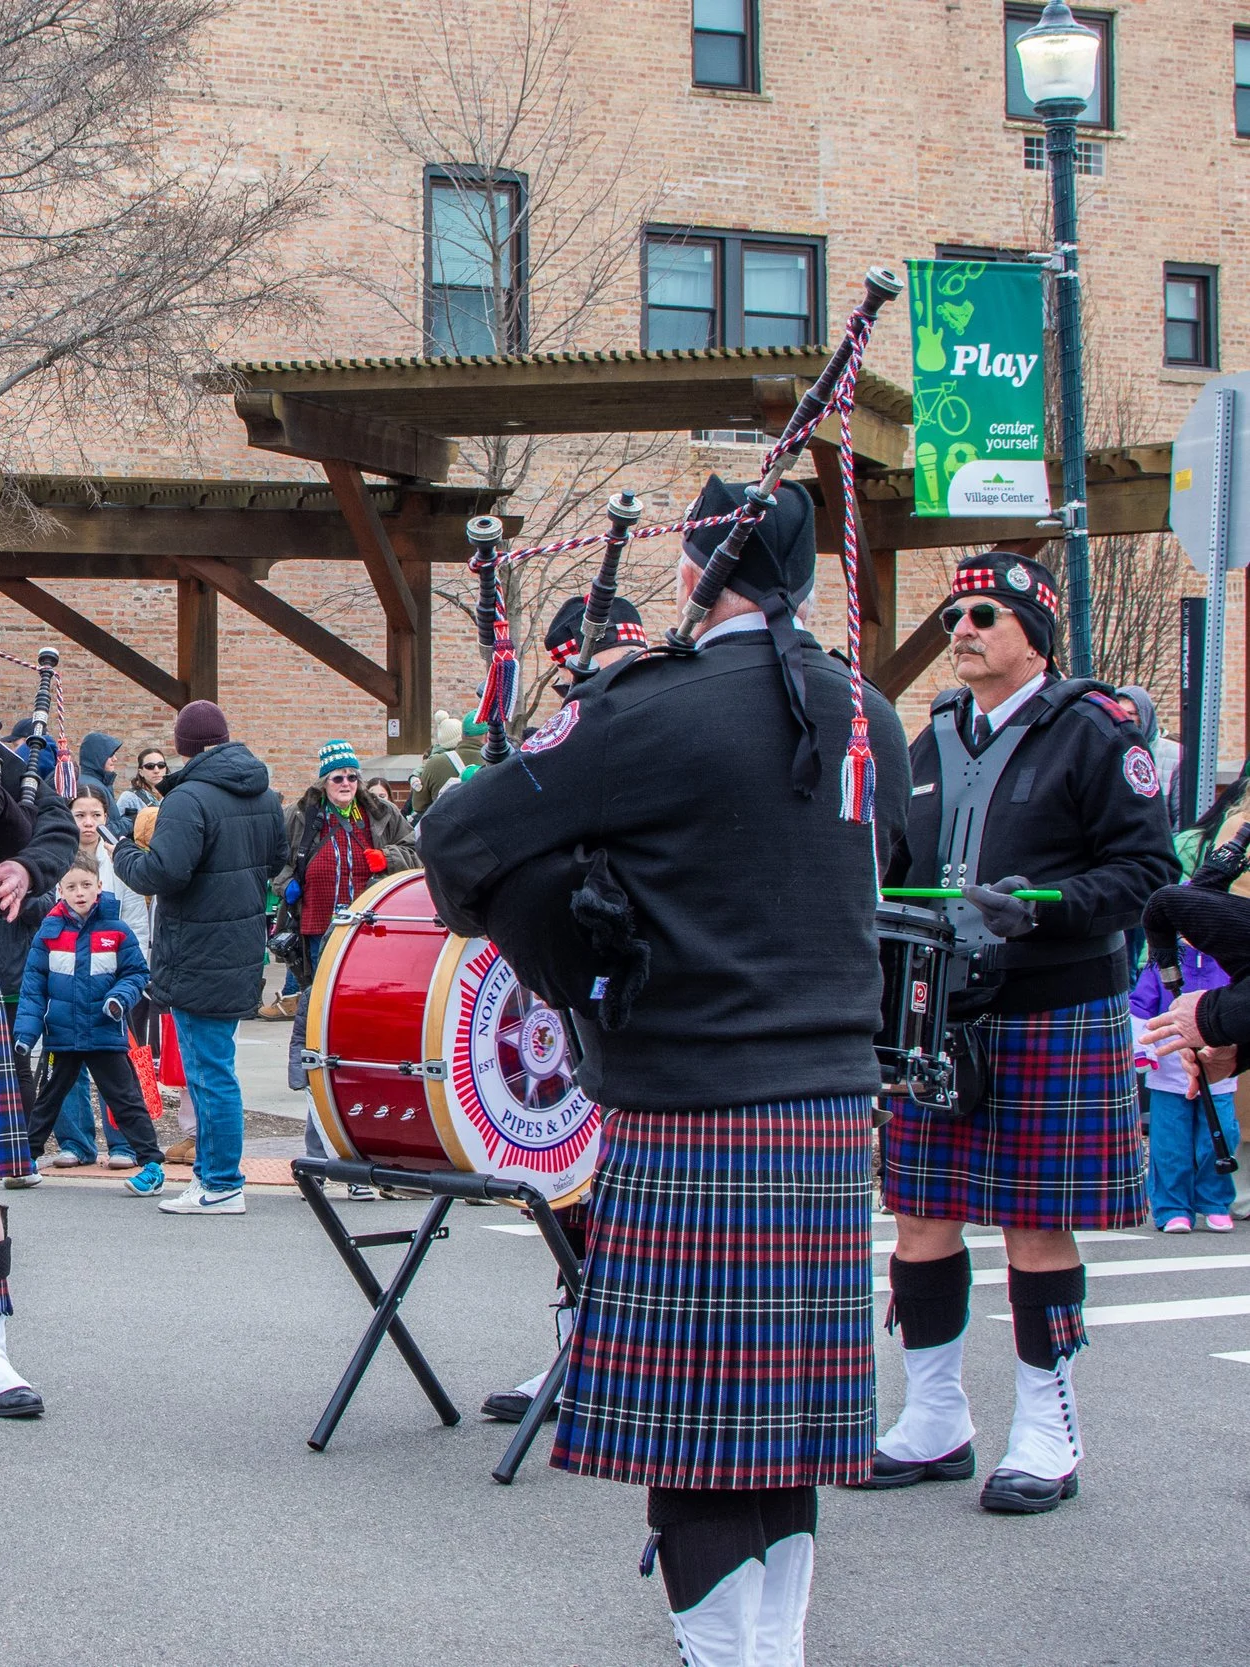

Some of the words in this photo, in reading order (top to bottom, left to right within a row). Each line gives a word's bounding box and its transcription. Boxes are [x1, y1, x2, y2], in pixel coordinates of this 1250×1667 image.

[950, 343, 1039, 388] Play
[989, 420, 1035, 436] center
[985, 434, 1039, 453] yourself
[964, 492, 999, 506] Village
[1000, 493, 1035, 504] Center
[478, 964, 513, 1038] NORTH
[477, 1057, 497, 1074] EST
[500, 1107, 543, 1138] PIPES
[546, 1118, 559, 1136] &
